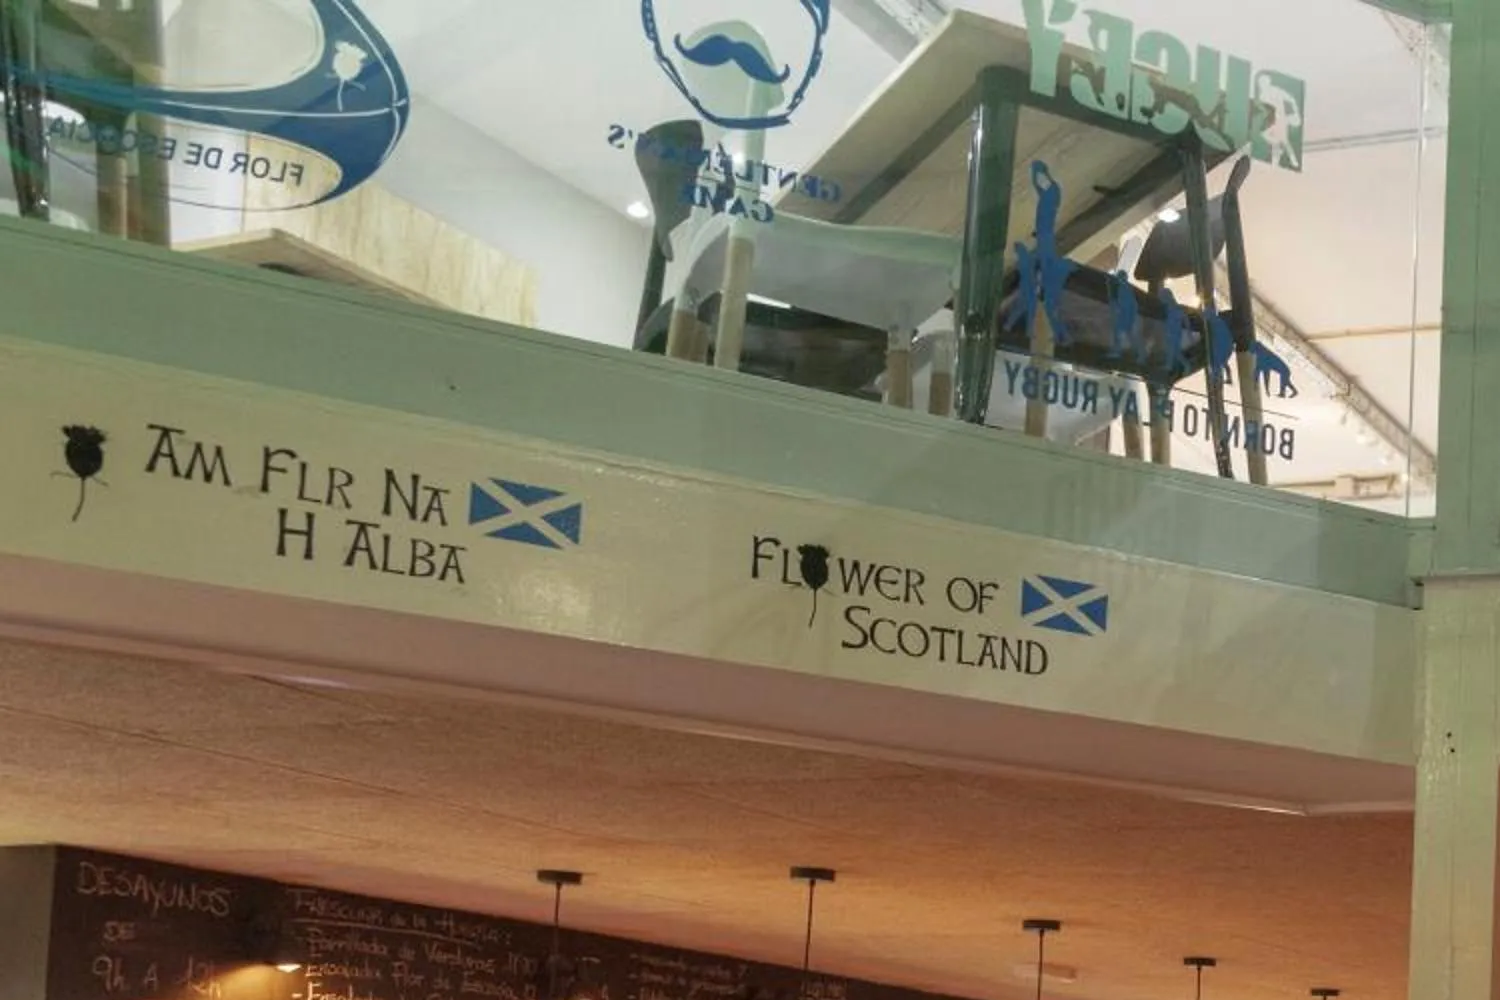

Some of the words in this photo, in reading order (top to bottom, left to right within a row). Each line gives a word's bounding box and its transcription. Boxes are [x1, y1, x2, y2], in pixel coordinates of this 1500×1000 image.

[145, 423, 232, 487] AM
[259, 446, 354, 509] FLR
[382, 467, 450, 527] NA
[276, 507, 315, 560] H
[343, 519, 468, 584] ALBA
[751, 535, 925, 606] FLWER
[946, 577, 999, 615] OF
[841, 606, 1049, 675] SCOTLAND
[77, 861, 230, 917] DESAYUNOS
